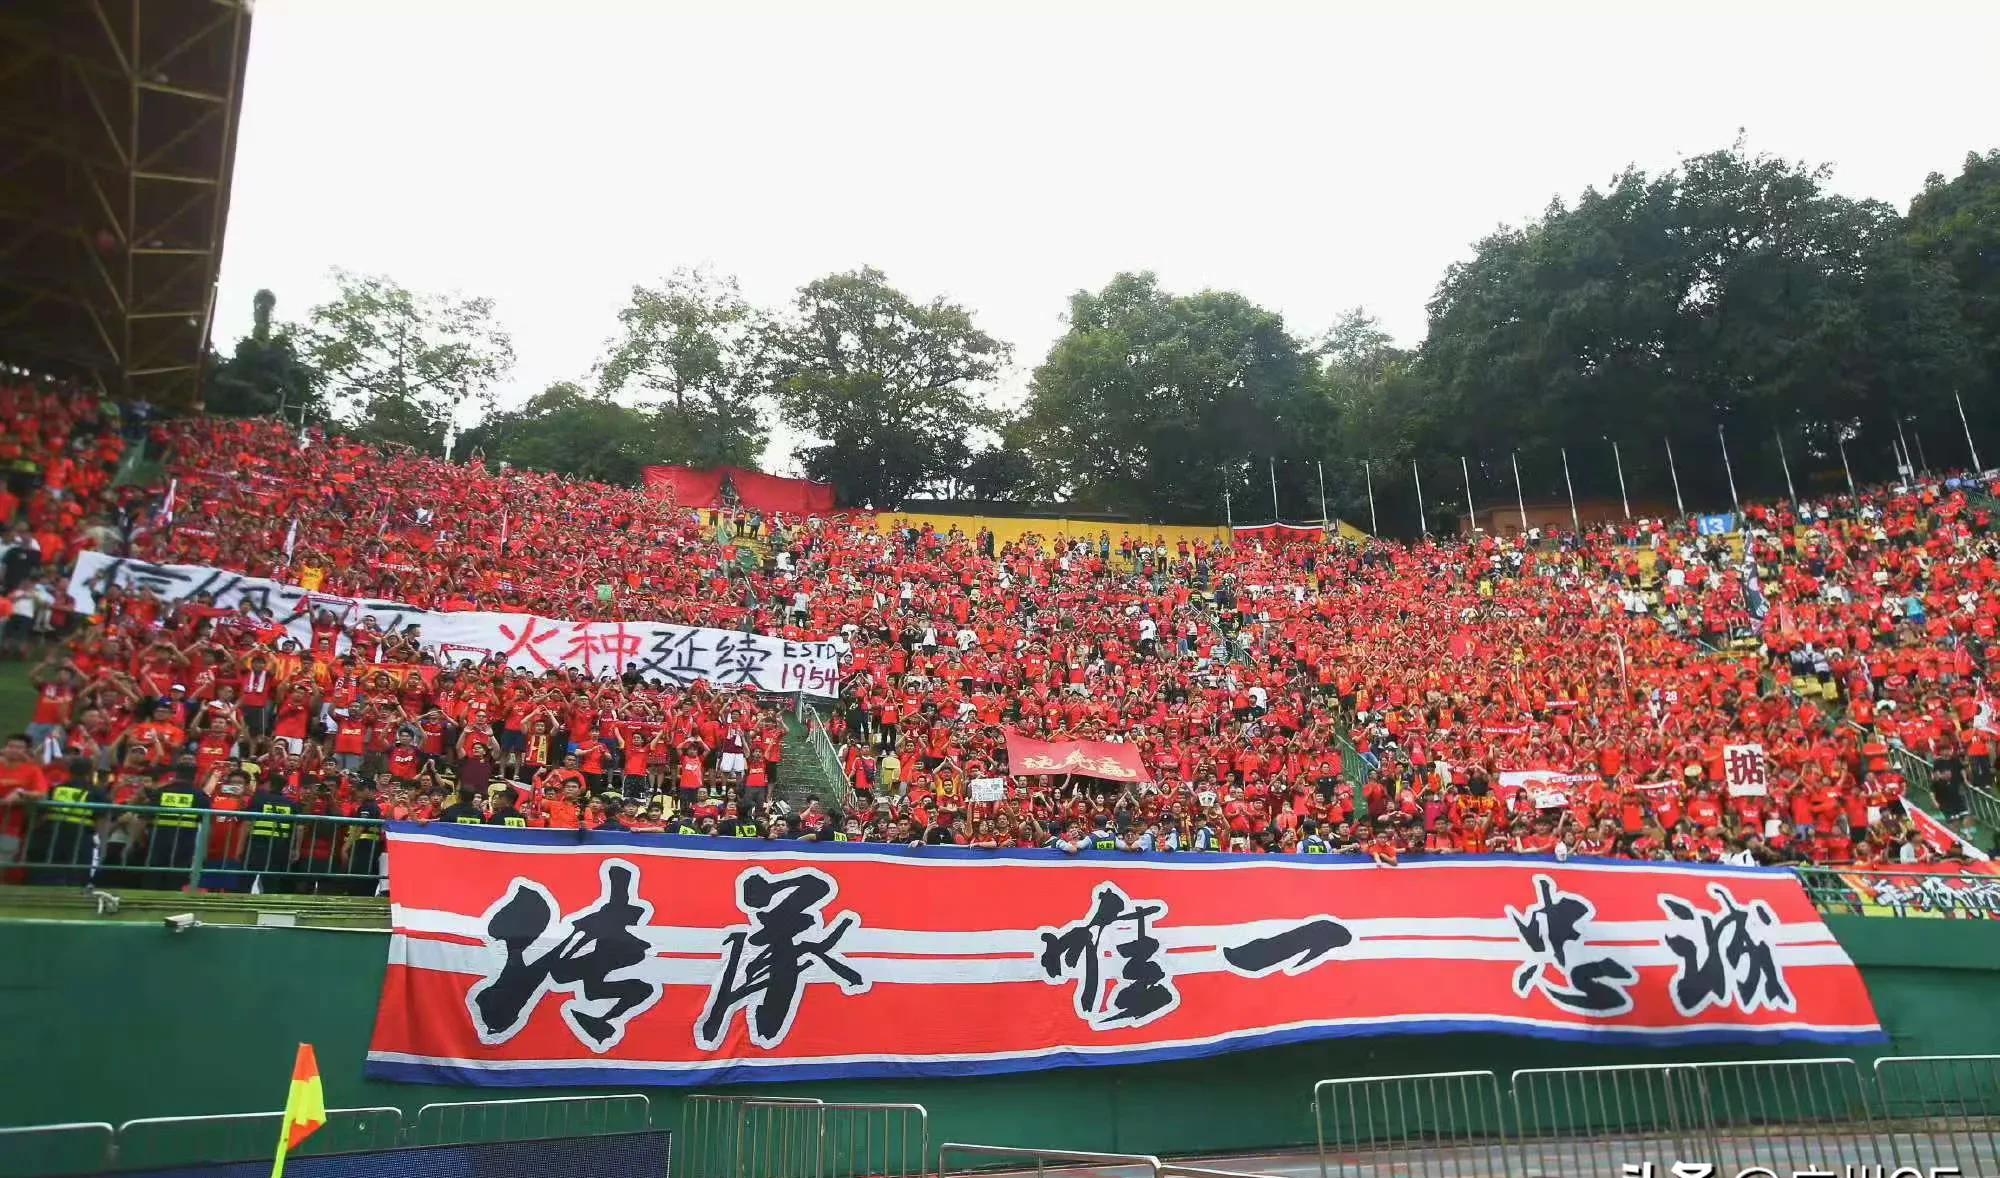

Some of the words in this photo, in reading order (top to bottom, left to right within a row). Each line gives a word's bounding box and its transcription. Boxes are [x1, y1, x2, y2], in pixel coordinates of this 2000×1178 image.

[497, 616, 772, 691] 火种延续
[783, 641, 837, 660] ESTD
[781, 663, 841, 696] 1954
[1664, 690, 1678, 702] 28
[470, 862, 870, 1051] 传承
[1039, 885, 1354, 1026] 唯一
[1510, 877, 1792, 1013] 忠诚
